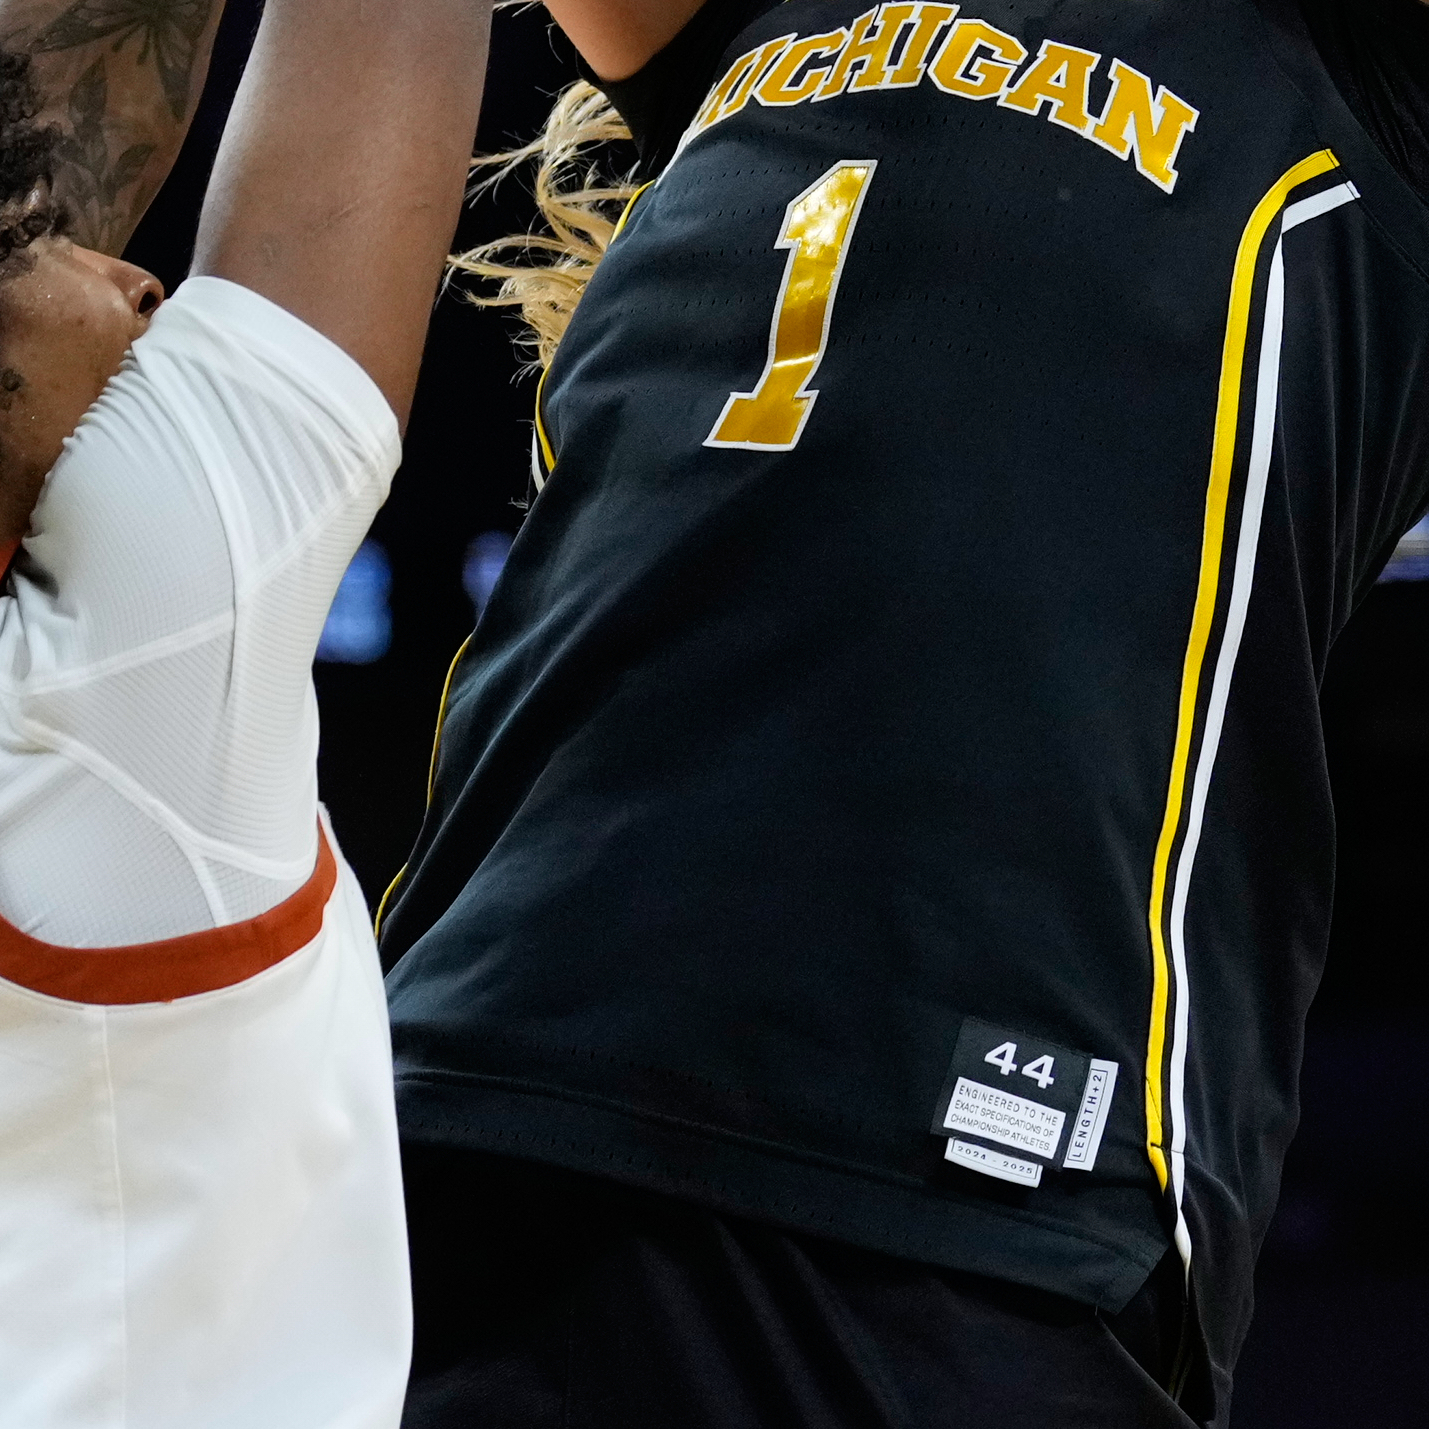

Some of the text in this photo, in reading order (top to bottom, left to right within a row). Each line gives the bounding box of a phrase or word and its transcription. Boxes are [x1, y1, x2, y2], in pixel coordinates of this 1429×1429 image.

[702, 159, 878, 451] 1
[984, 1041, 1055, 1090] 44
[954, 1099, 1054, 1138] EXACT SPECIFICATIONS OF
[958, 1084, 1058, 1127] ENGINEERED TO THE
[950, 1113, 1051, 1152] CHAMPIONSHIP ATHLETES.
[1002, 1160, 1033, 1174] 2025
